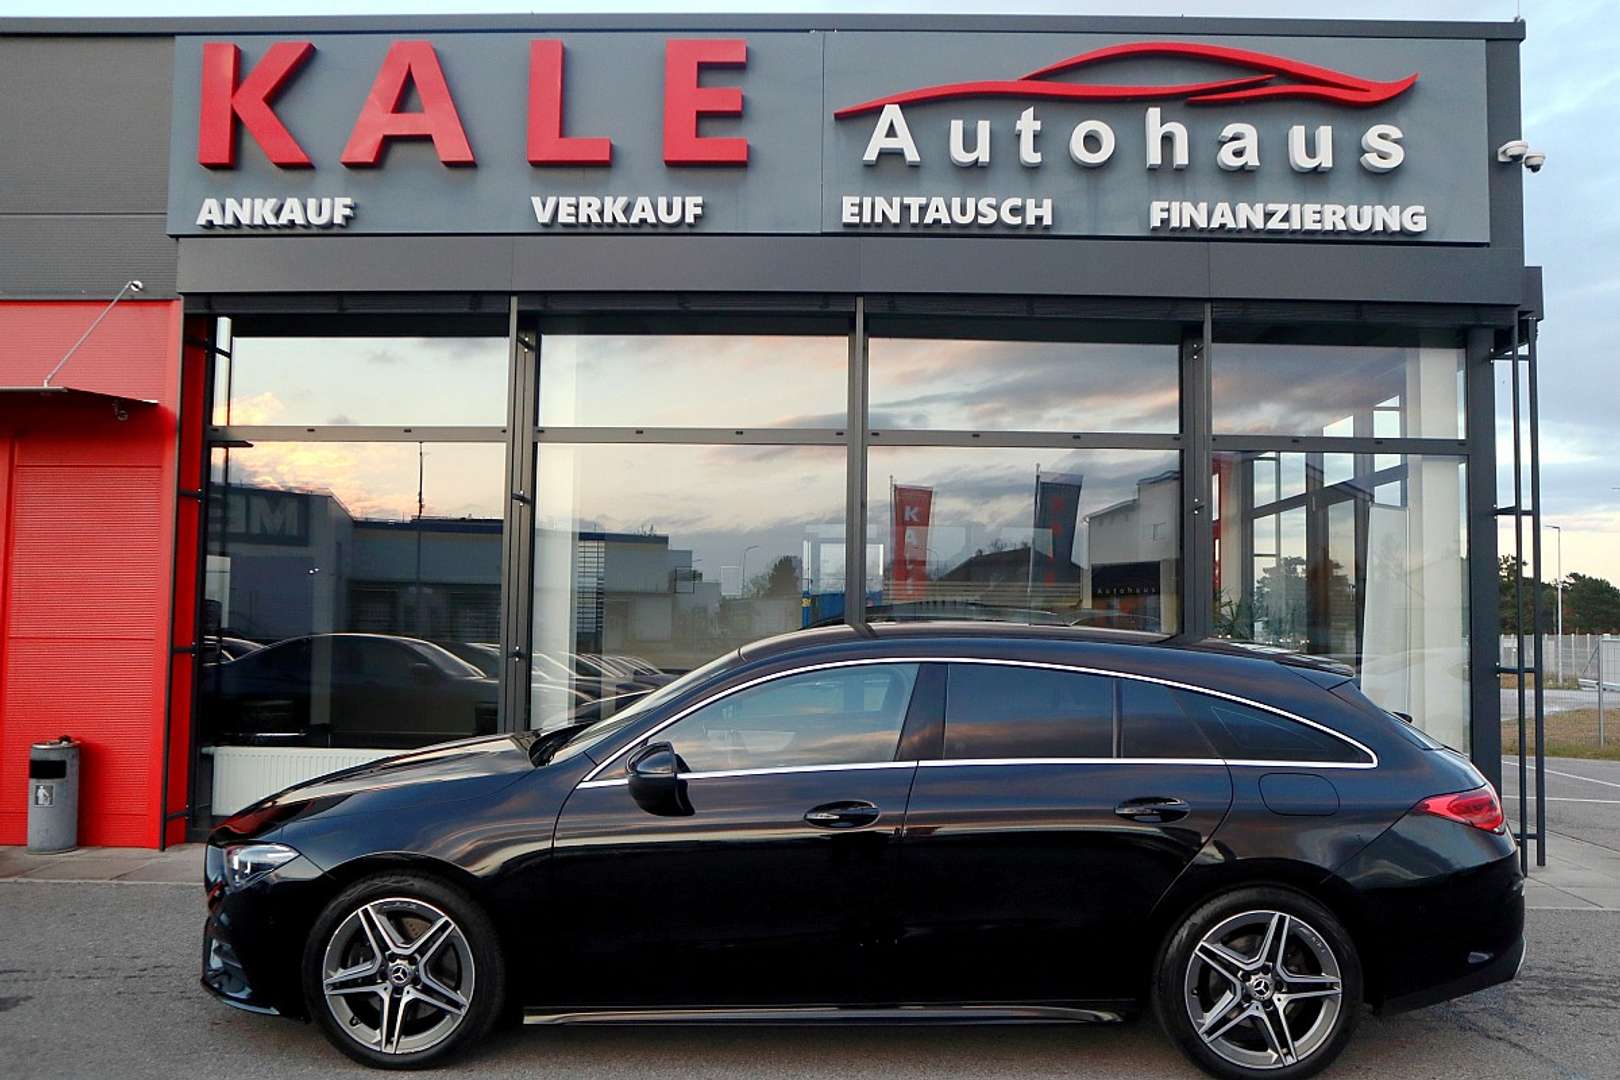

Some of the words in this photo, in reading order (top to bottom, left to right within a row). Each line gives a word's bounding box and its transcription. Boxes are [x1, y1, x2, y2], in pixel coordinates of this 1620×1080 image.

[198, 39, 749, 168] KALE
[863, 104, 1405, 172] Autohaus
[196, 197, 355, 228] ANKAUF
[531, 195, 704, 226] VERKAUF
[841, 195, 1054, 228] EINTAUSCH
[1149, 200, 1428, 233] FINANZIERUNG
